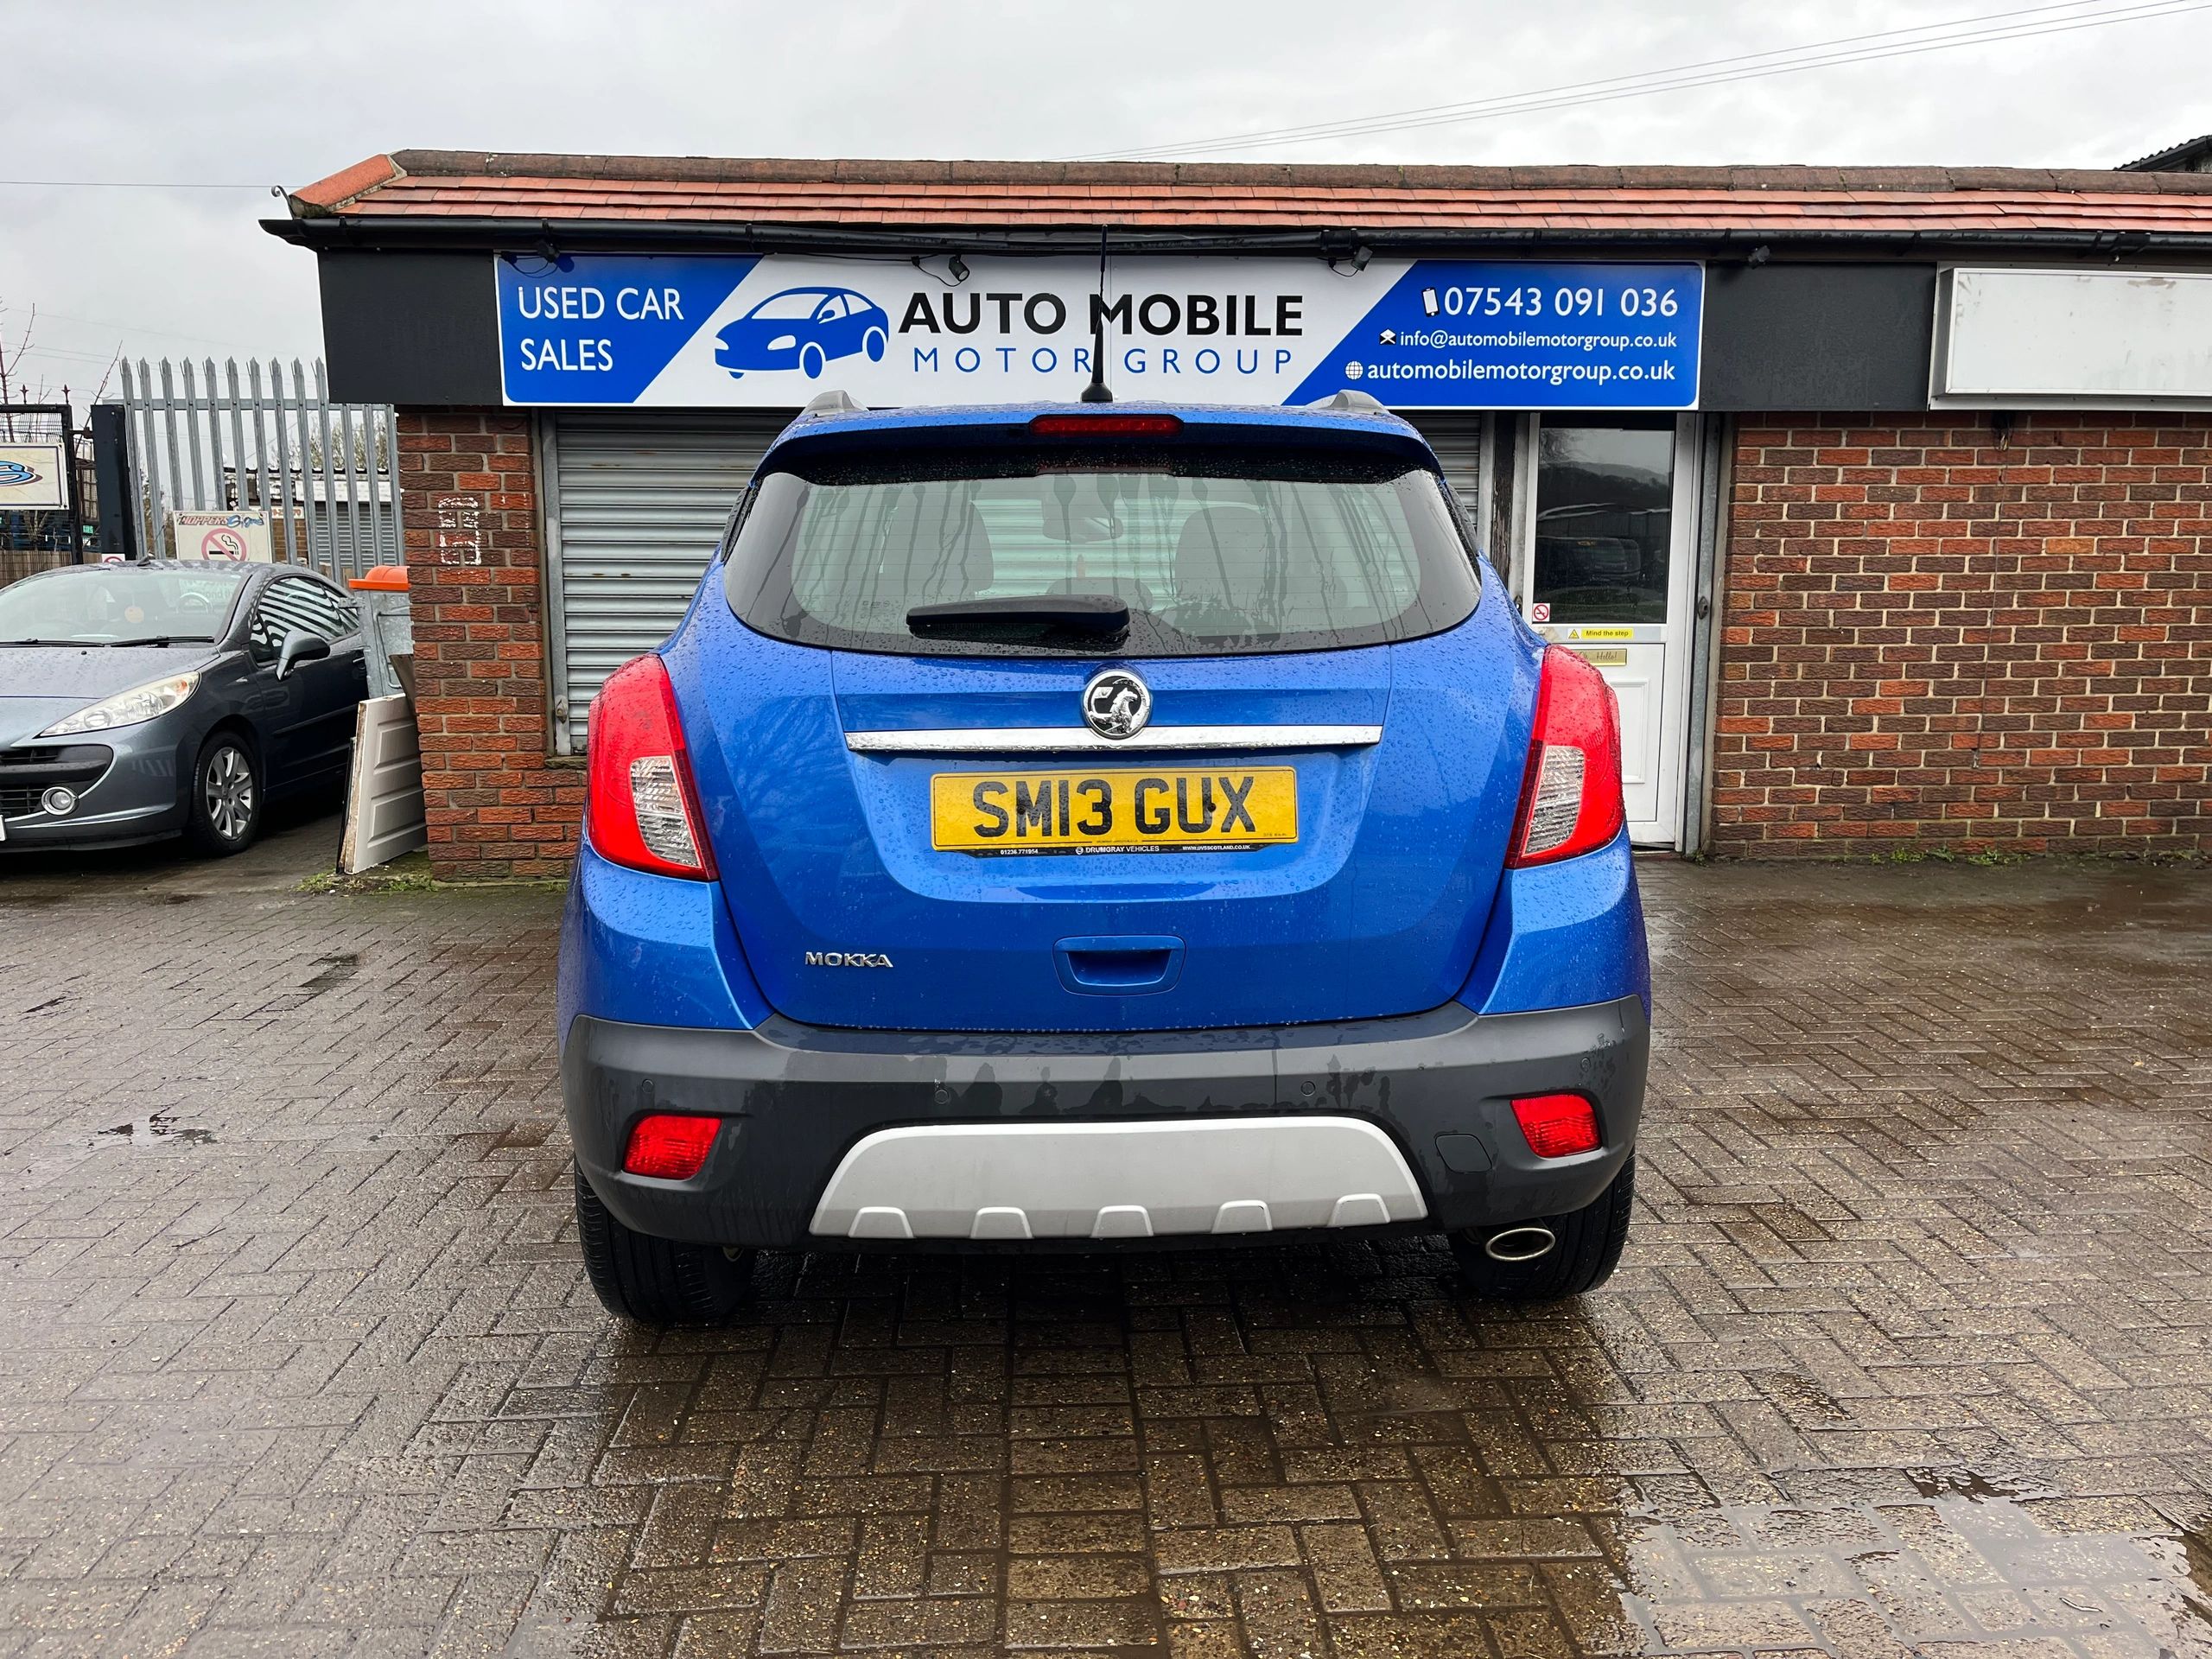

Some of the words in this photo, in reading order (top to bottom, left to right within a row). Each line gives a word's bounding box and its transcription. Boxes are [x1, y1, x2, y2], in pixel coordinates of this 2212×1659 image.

[518, 286, 605, 320] USED
[616, 288, 684, 321] CAR
[898, 292, 1067, 334] AUTO
[1090, 293, 1303, 336] MOBILE
[1444, 287, 1542, 316] 07543
[1554, 287, 1604, 316] 091
[1620, 288, 1679, 317] 036
[521, 339, 613, 372] SALES
[1400, 329, 1678, 352] info@automobilemotorgroup.co.uk
[913, 346, 1092, 373] MOTOR
[1124, 348, 1292, 375] GROUP
[1368, 359, 1675, 385] automobilemotorgroup.co.uk
[973, 779, 1112, 838] SM13
[1135, 776, 1256, 836] GUX
[804, 951, 893, 968] MOKKA
